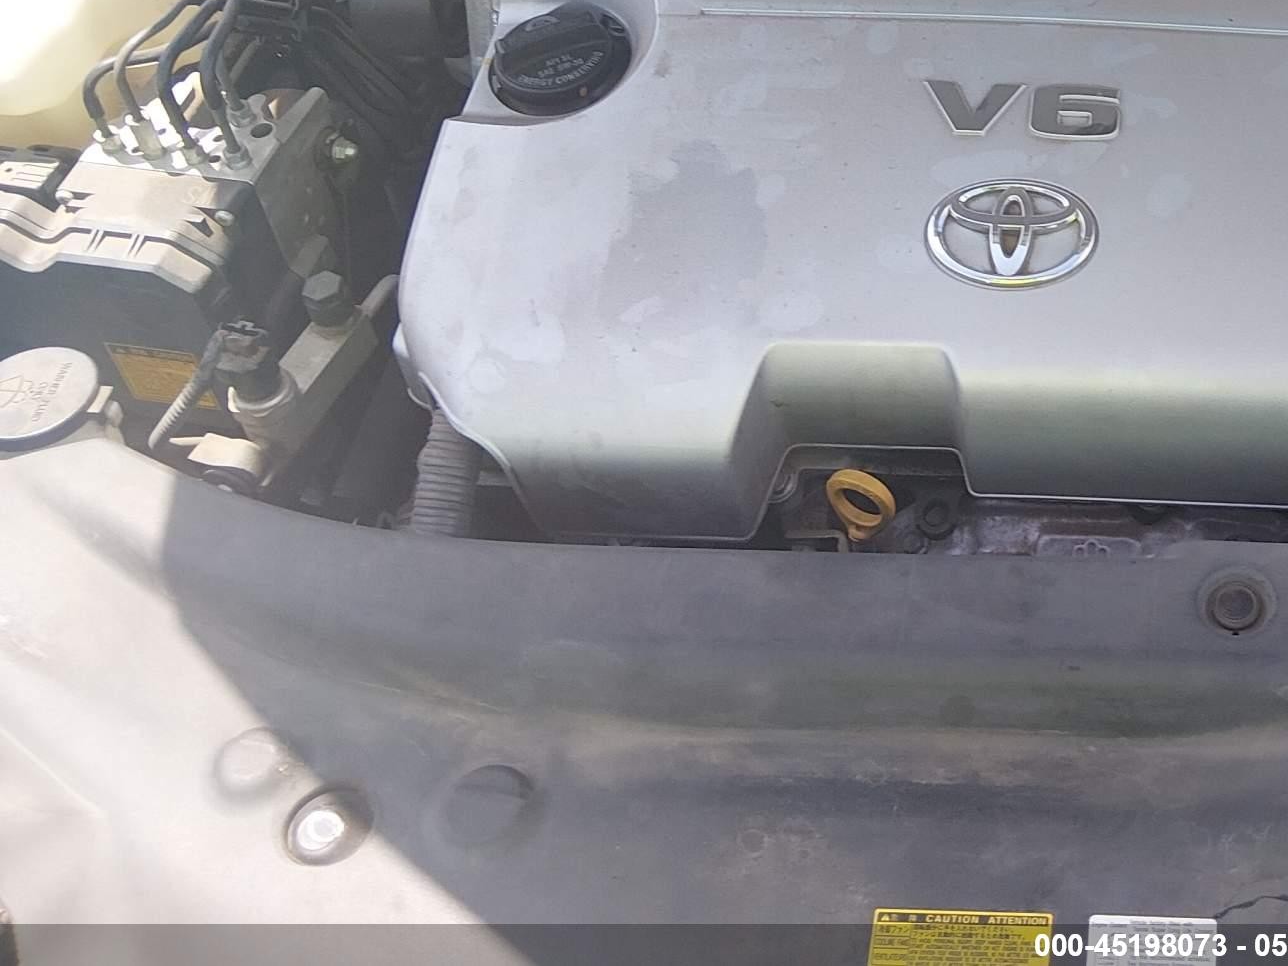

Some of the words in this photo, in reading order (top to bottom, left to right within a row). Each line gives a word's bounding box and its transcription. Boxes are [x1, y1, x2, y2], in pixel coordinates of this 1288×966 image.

[517, 74, 553, 86] ENERGY
[554, 51, 605, 85] CONSERVING
[922, 78, 1123, 140] V6
[925, 914, 980, 924] CAUTION
[987, 915, 1048, 926] ATTENTION
